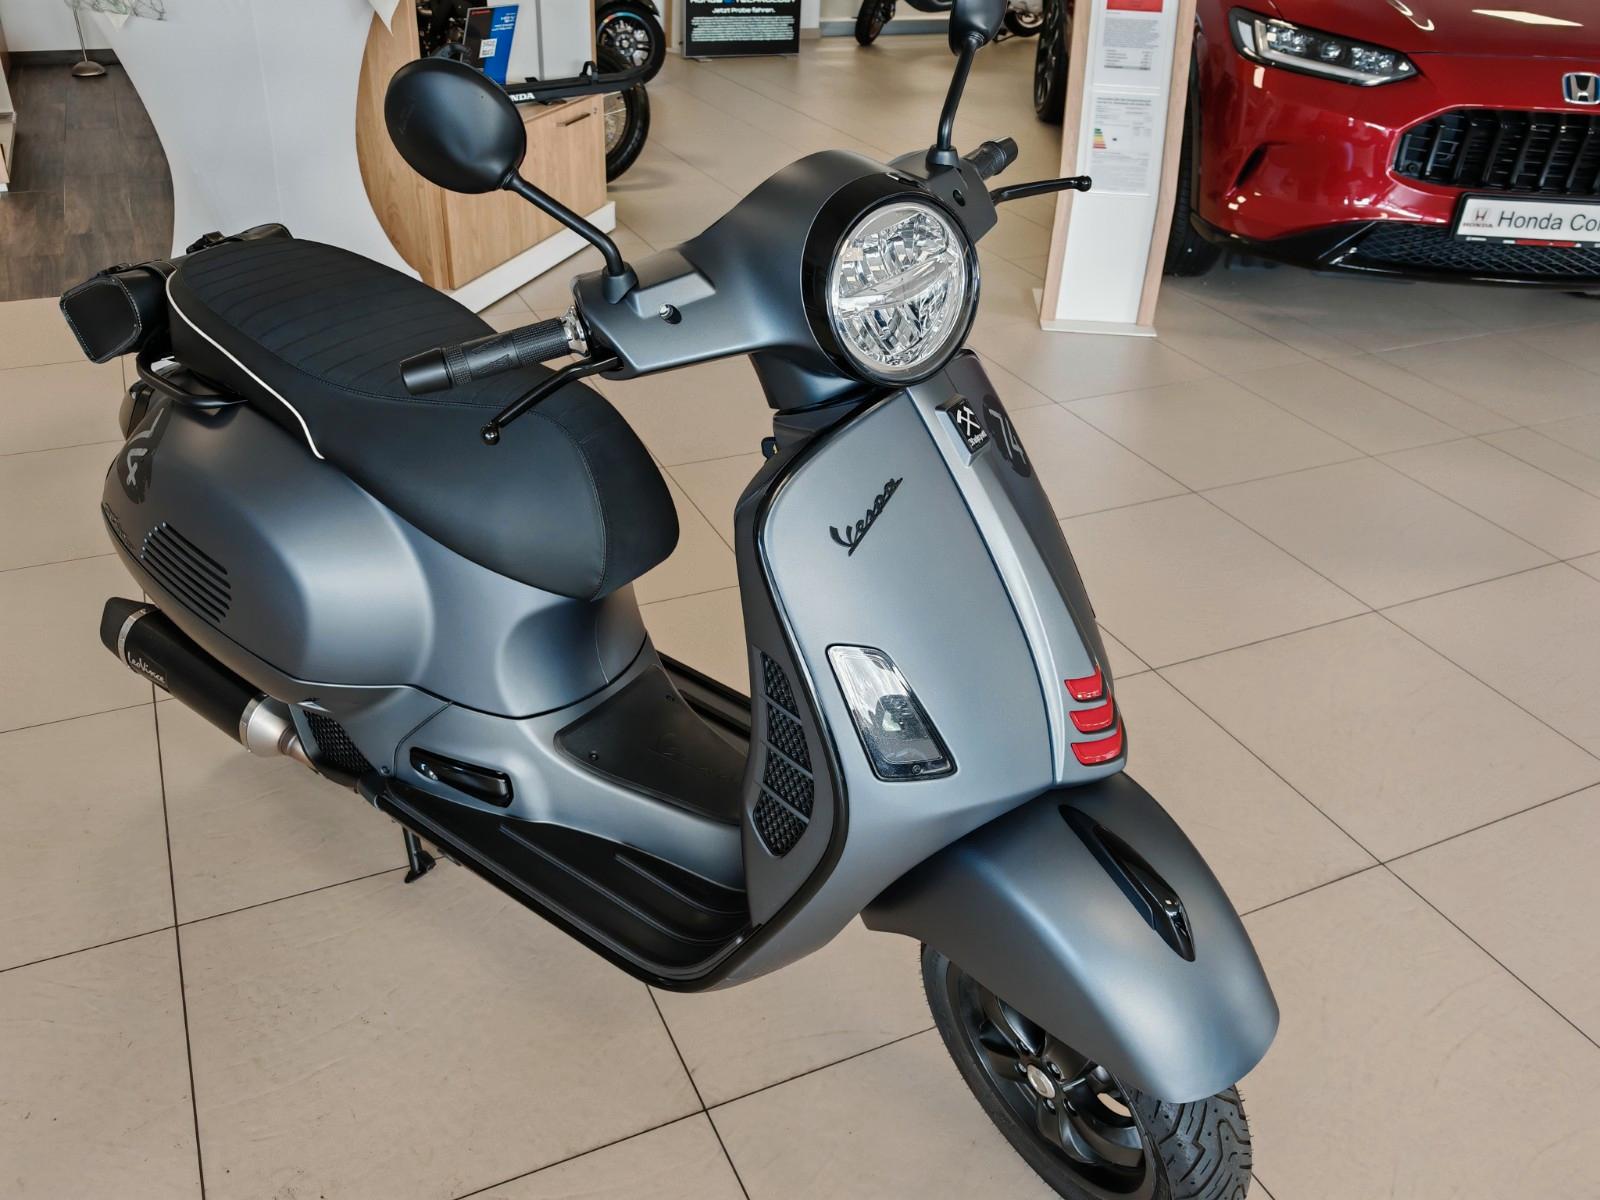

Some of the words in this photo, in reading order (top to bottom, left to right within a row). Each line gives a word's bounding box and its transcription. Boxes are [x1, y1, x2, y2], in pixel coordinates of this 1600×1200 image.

[508, 92, 536, 102] NDA
[1497, 210, 1563, 230] Honda
[1570, 213, 1600, 232] Co
[829, 476, 904, 558] Vespa
